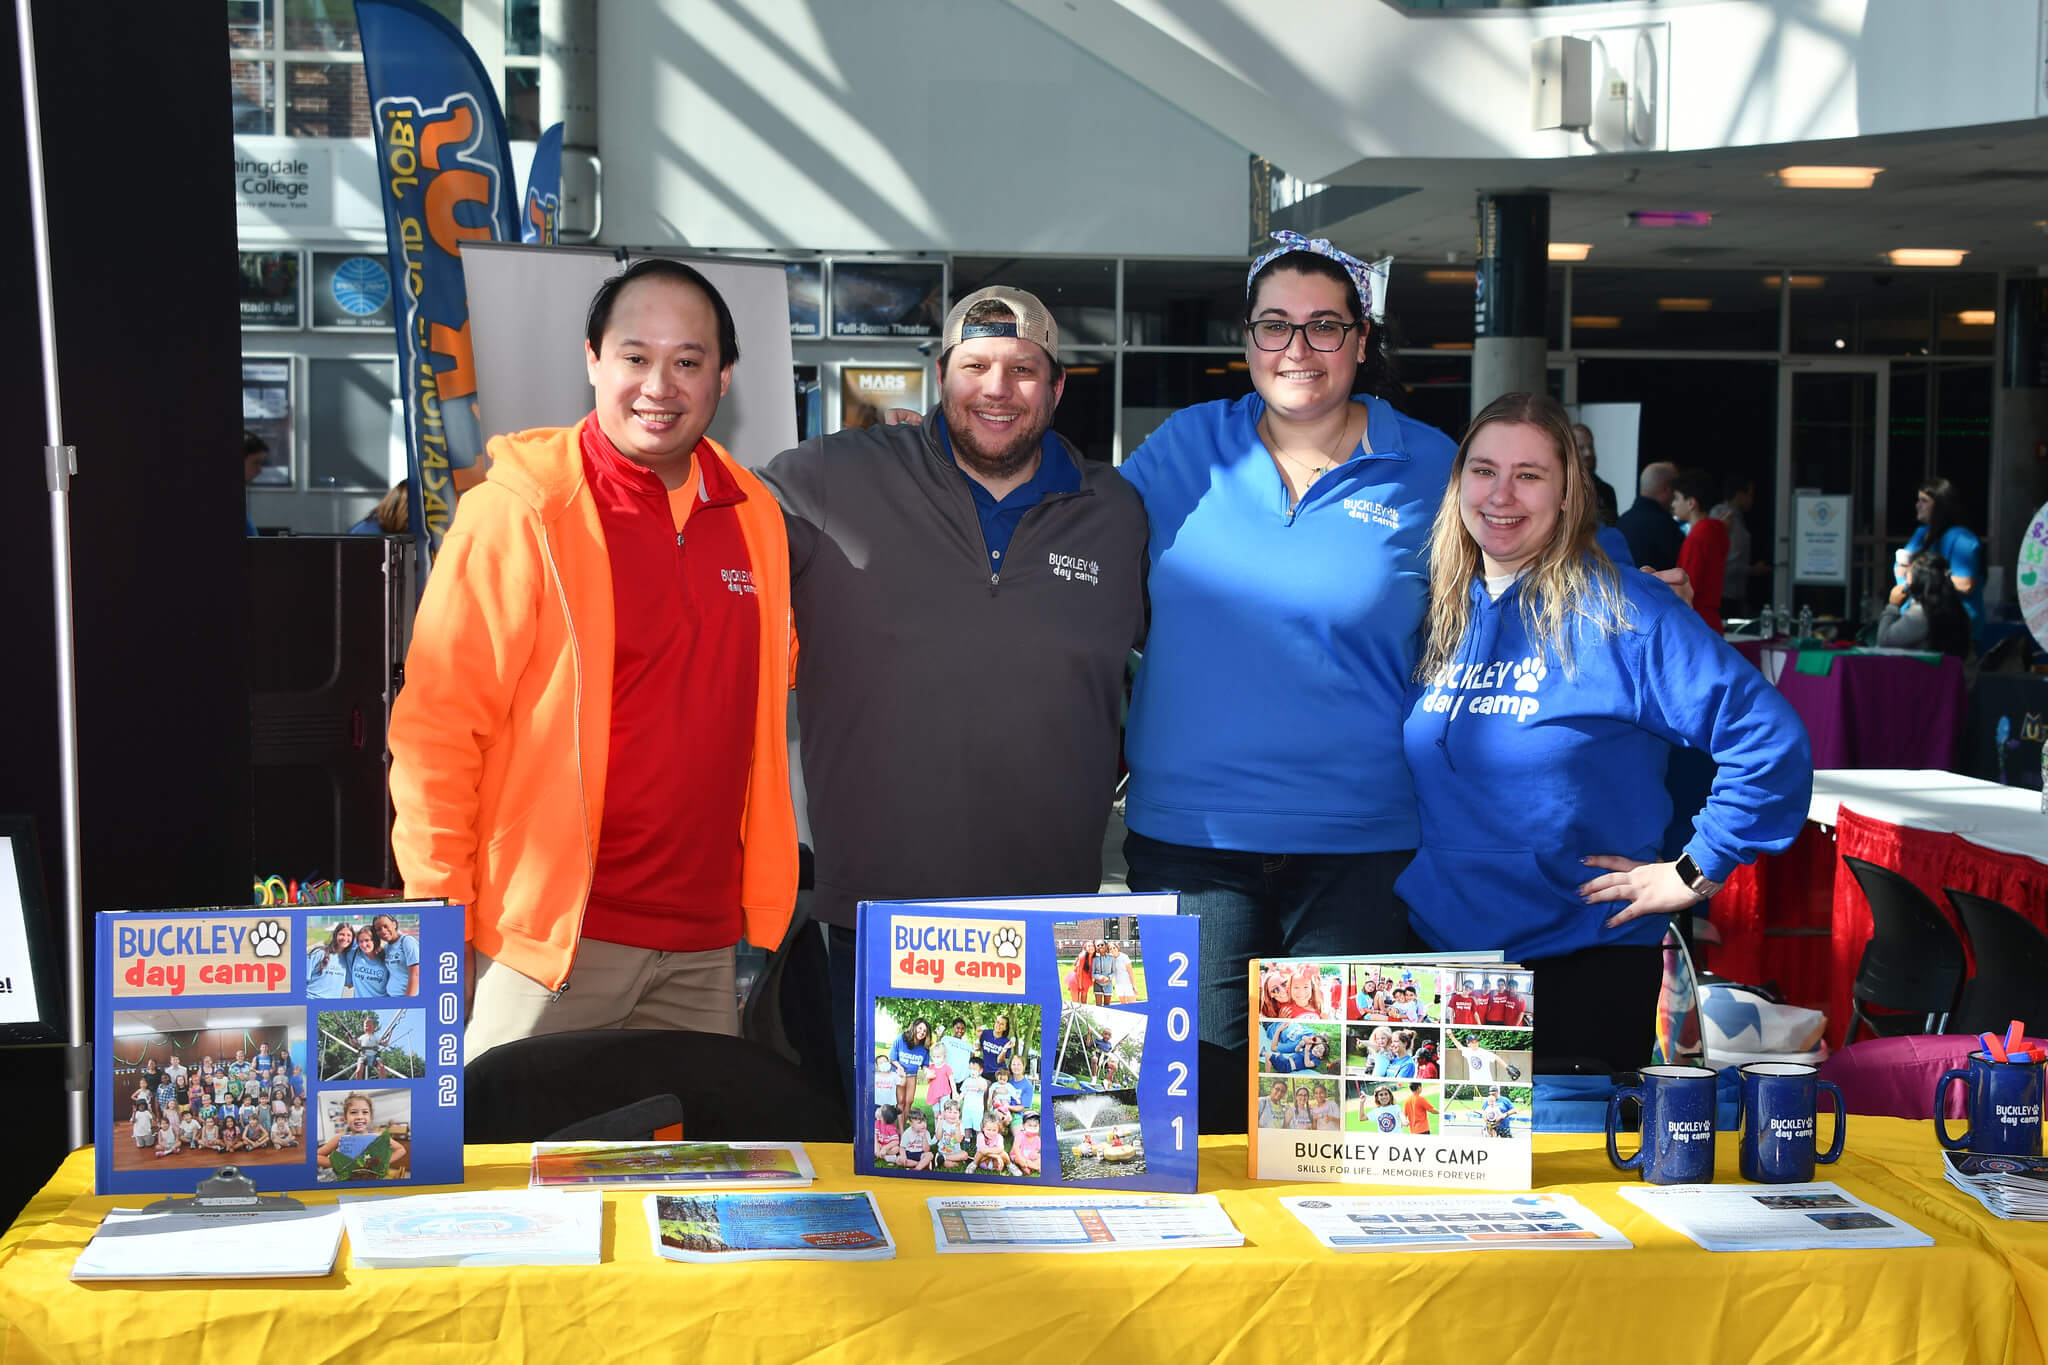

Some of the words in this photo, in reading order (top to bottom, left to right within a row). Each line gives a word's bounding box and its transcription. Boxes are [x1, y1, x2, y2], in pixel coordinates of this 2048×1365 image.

[235, 160, 309, 177] ingdale
[242, 179, 309, 199] College
[240, 302, 271, 312] rcade
[791, 323, 816, 333] rium
[892, 323, 931, 335] Theater
[859, 374, 906, 390] MARS
[1344, 499, 1388, 516] BUCKLEY
[1348, 510, 1369, 523] day
[1372, 515, 1399, 530] camp
[1048, 553, 1089, 572] BUCKLEY
[1053, 565, 1072, 581] day
[1075, 572, 1099, 586] camp
[1423, 687, 1465, 722] day
[1469, 694, 1540, 723] camp
[119, 925, 247, 958] BUCKLEY
[895, 926, 991, 953] BUCKLEY
[125, 959, 186, 995] day
[199, 962, 287, 991] camp
[900, 952, 945, 984] day
[955, 958, 1022, 986] camp
[438, 952, 458, 1107] 2022
[1167, 952, 1190, 1151] 2021
[1996, 1105, 2033, 1116] BUCKLEY
[1668, 1120, 1704, 1132] BUCKLEY
[1770, 1119, 1808, 1130] BUCKLEY
[2000, 1115, 2018, 1126] day
[2020, 1116, 2039, 1125] camp
[1673, 1131, 1689, 1143] day
[1692, 1131, 1711, 1141] camp
[1775, 1129, 1792, 1141] day
[1795, 1128, 1814, 1139] camp
[1295, 1143, 1380, 1161] BUCKLEY
[1388, 1147, 1426, 1164] DAY
[1435, 1149, 1488, 1165] CAMP
[1297, 1165, 1327, 1174] SKILLS
[1330, 1166, 1350, 1175] FOR
[1382, 1168, 1434, 1178] MEMORIES
[1437, 1170, 1486, 1181] FOREVER!
